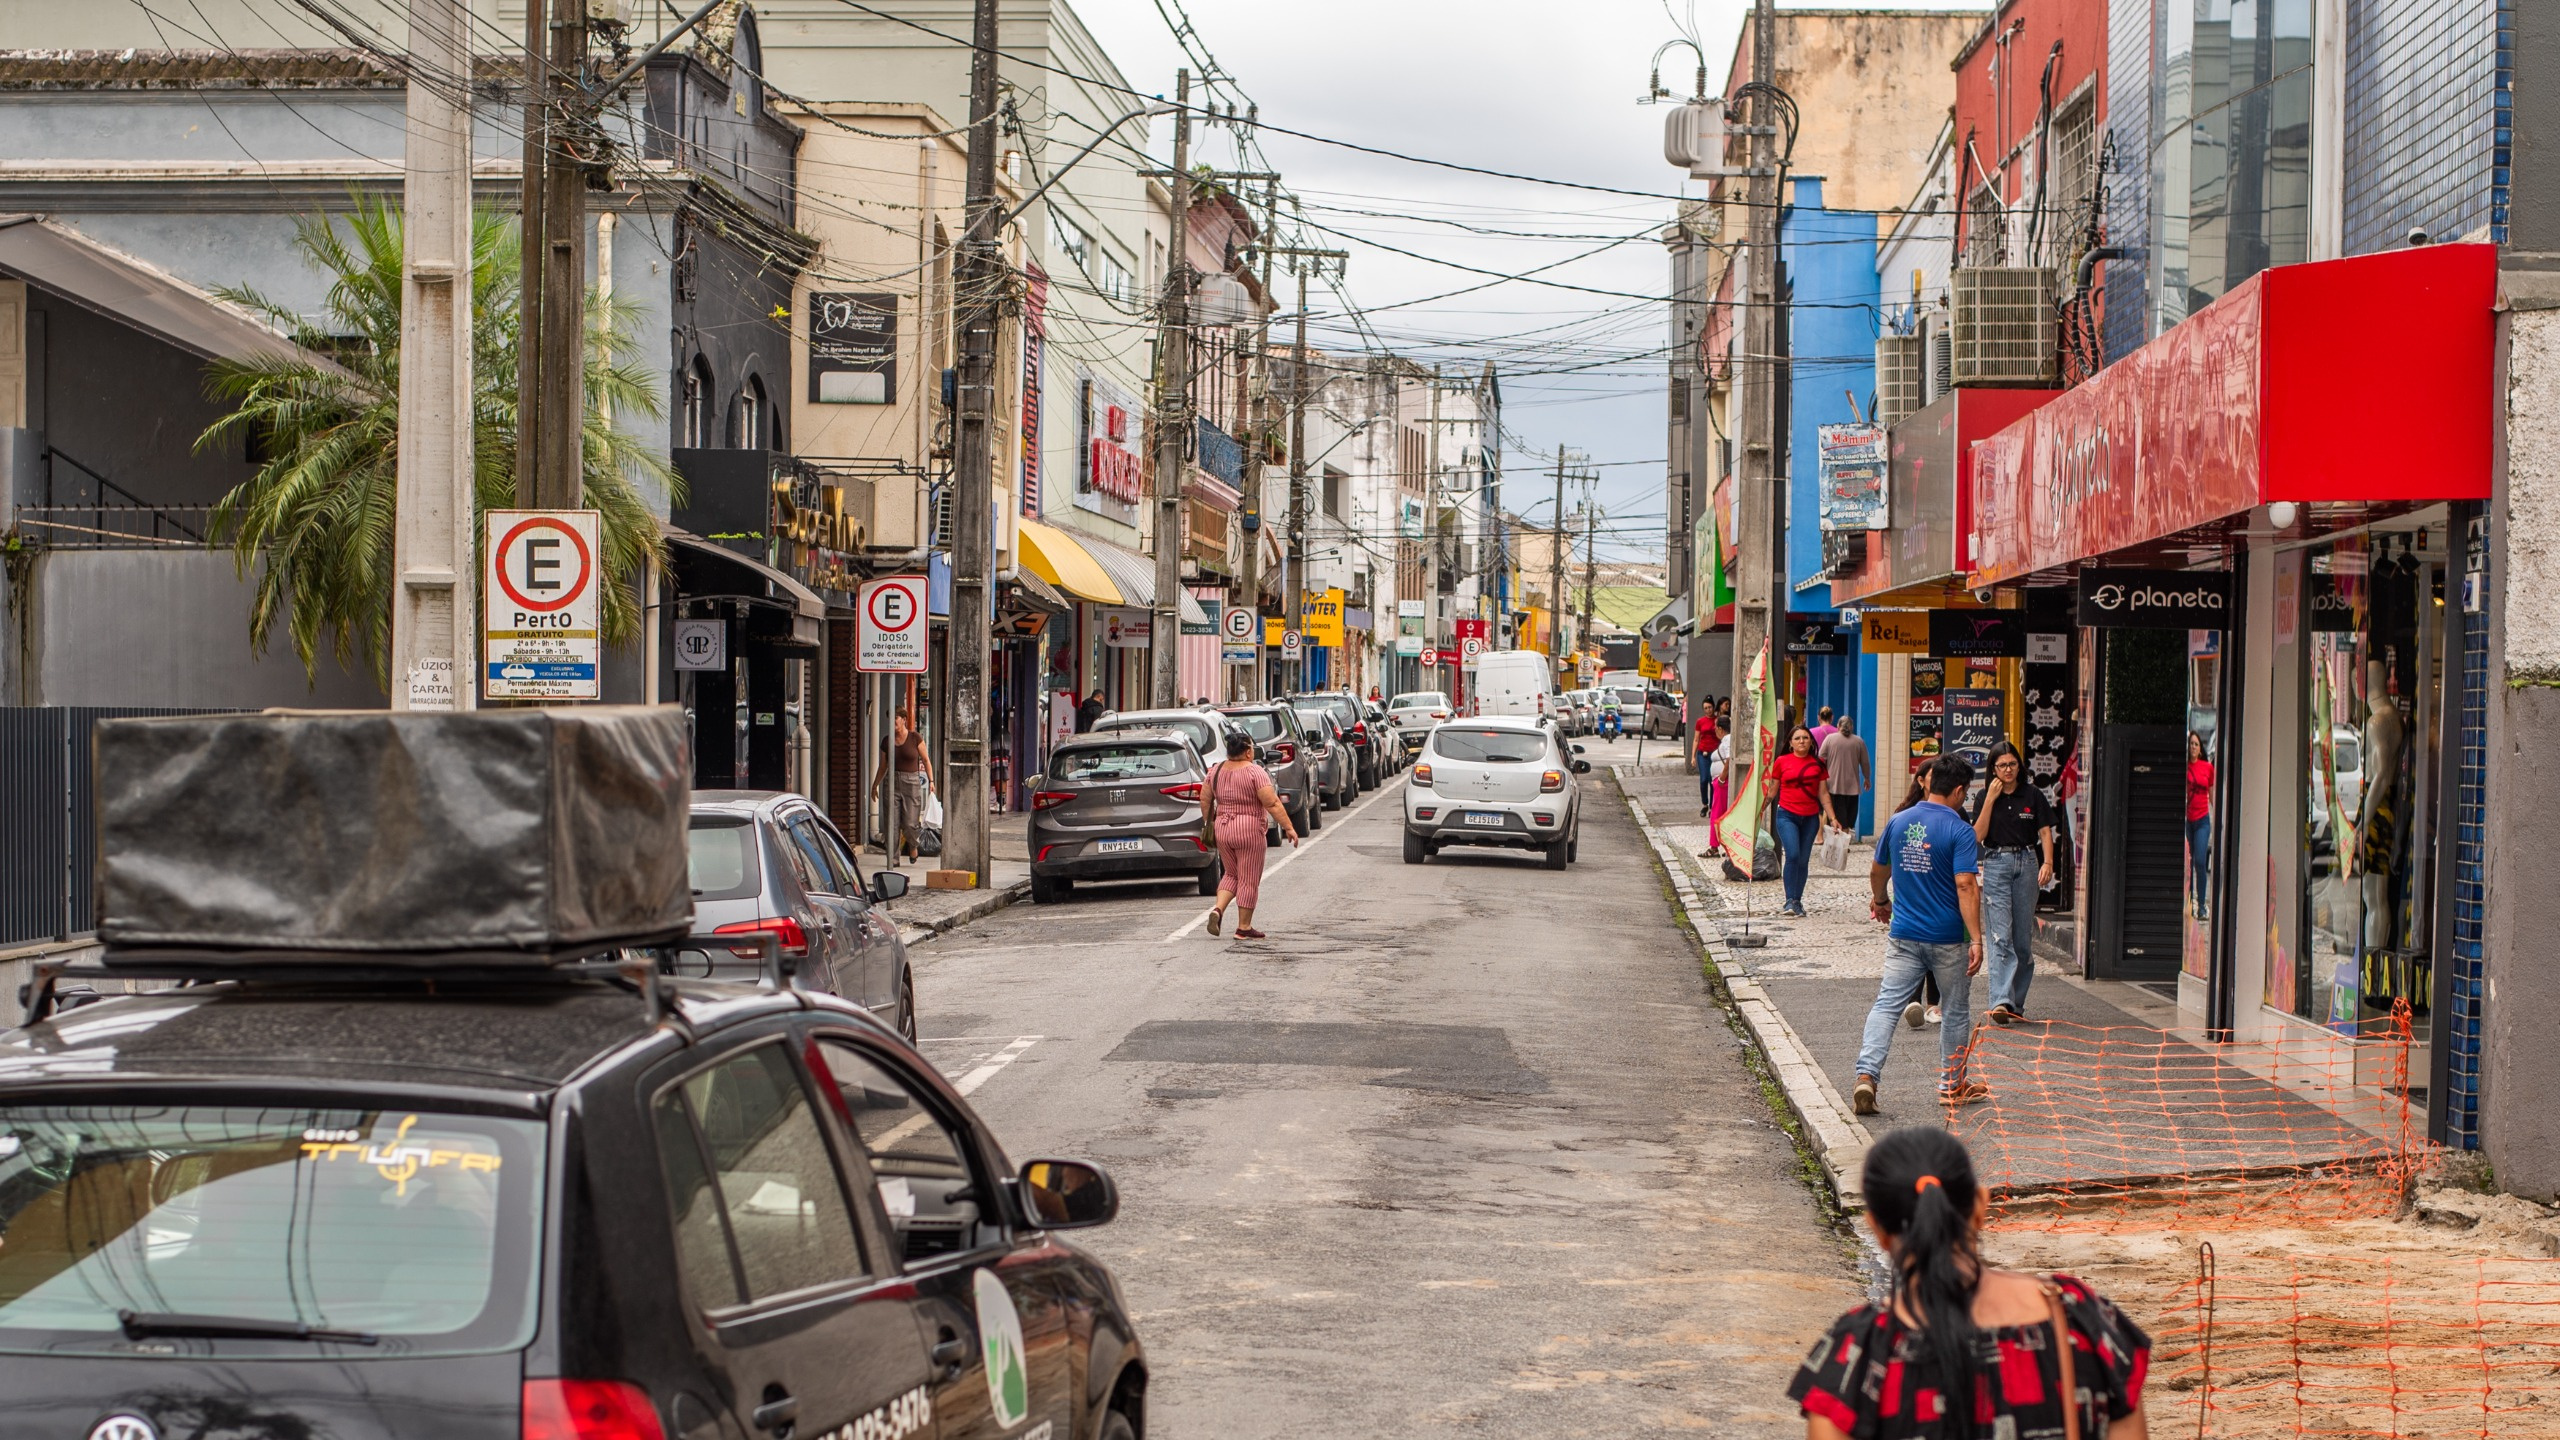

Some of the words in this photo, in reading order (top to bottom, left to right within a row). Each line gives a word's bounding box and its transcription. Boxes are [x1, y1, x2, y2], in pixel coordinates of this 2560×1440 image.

[1832, 428, 1882, 444] Mammi's
[1844, 503, 1858, 511] SUBA
[526, 539, 560, 589] E
[2131, 586, 2223, 611] planeta
[885, 595, 900, 619] E
[1235, 616, 1244, 631] E
[1870, 624, 1900, 640] Rei
[1288, 635, 1294, 645] E
[1469, 643, 1475, 651] E
[1899, 638, 1928, 646] Salgad
[1949, 637, 2004, 650] euphoria
[513, 647, 540, 655] Sábados
[1971, 657, 1994, 665] Pastel
[432, 674, 439, 682] &
[1952, 712, 1997, 727] Buffet
[1952, 729, 1993, 745] Livre
[2364, 954, 2432, 1009] SALDO
[303, 1129, 360, 1141] GRUPO
